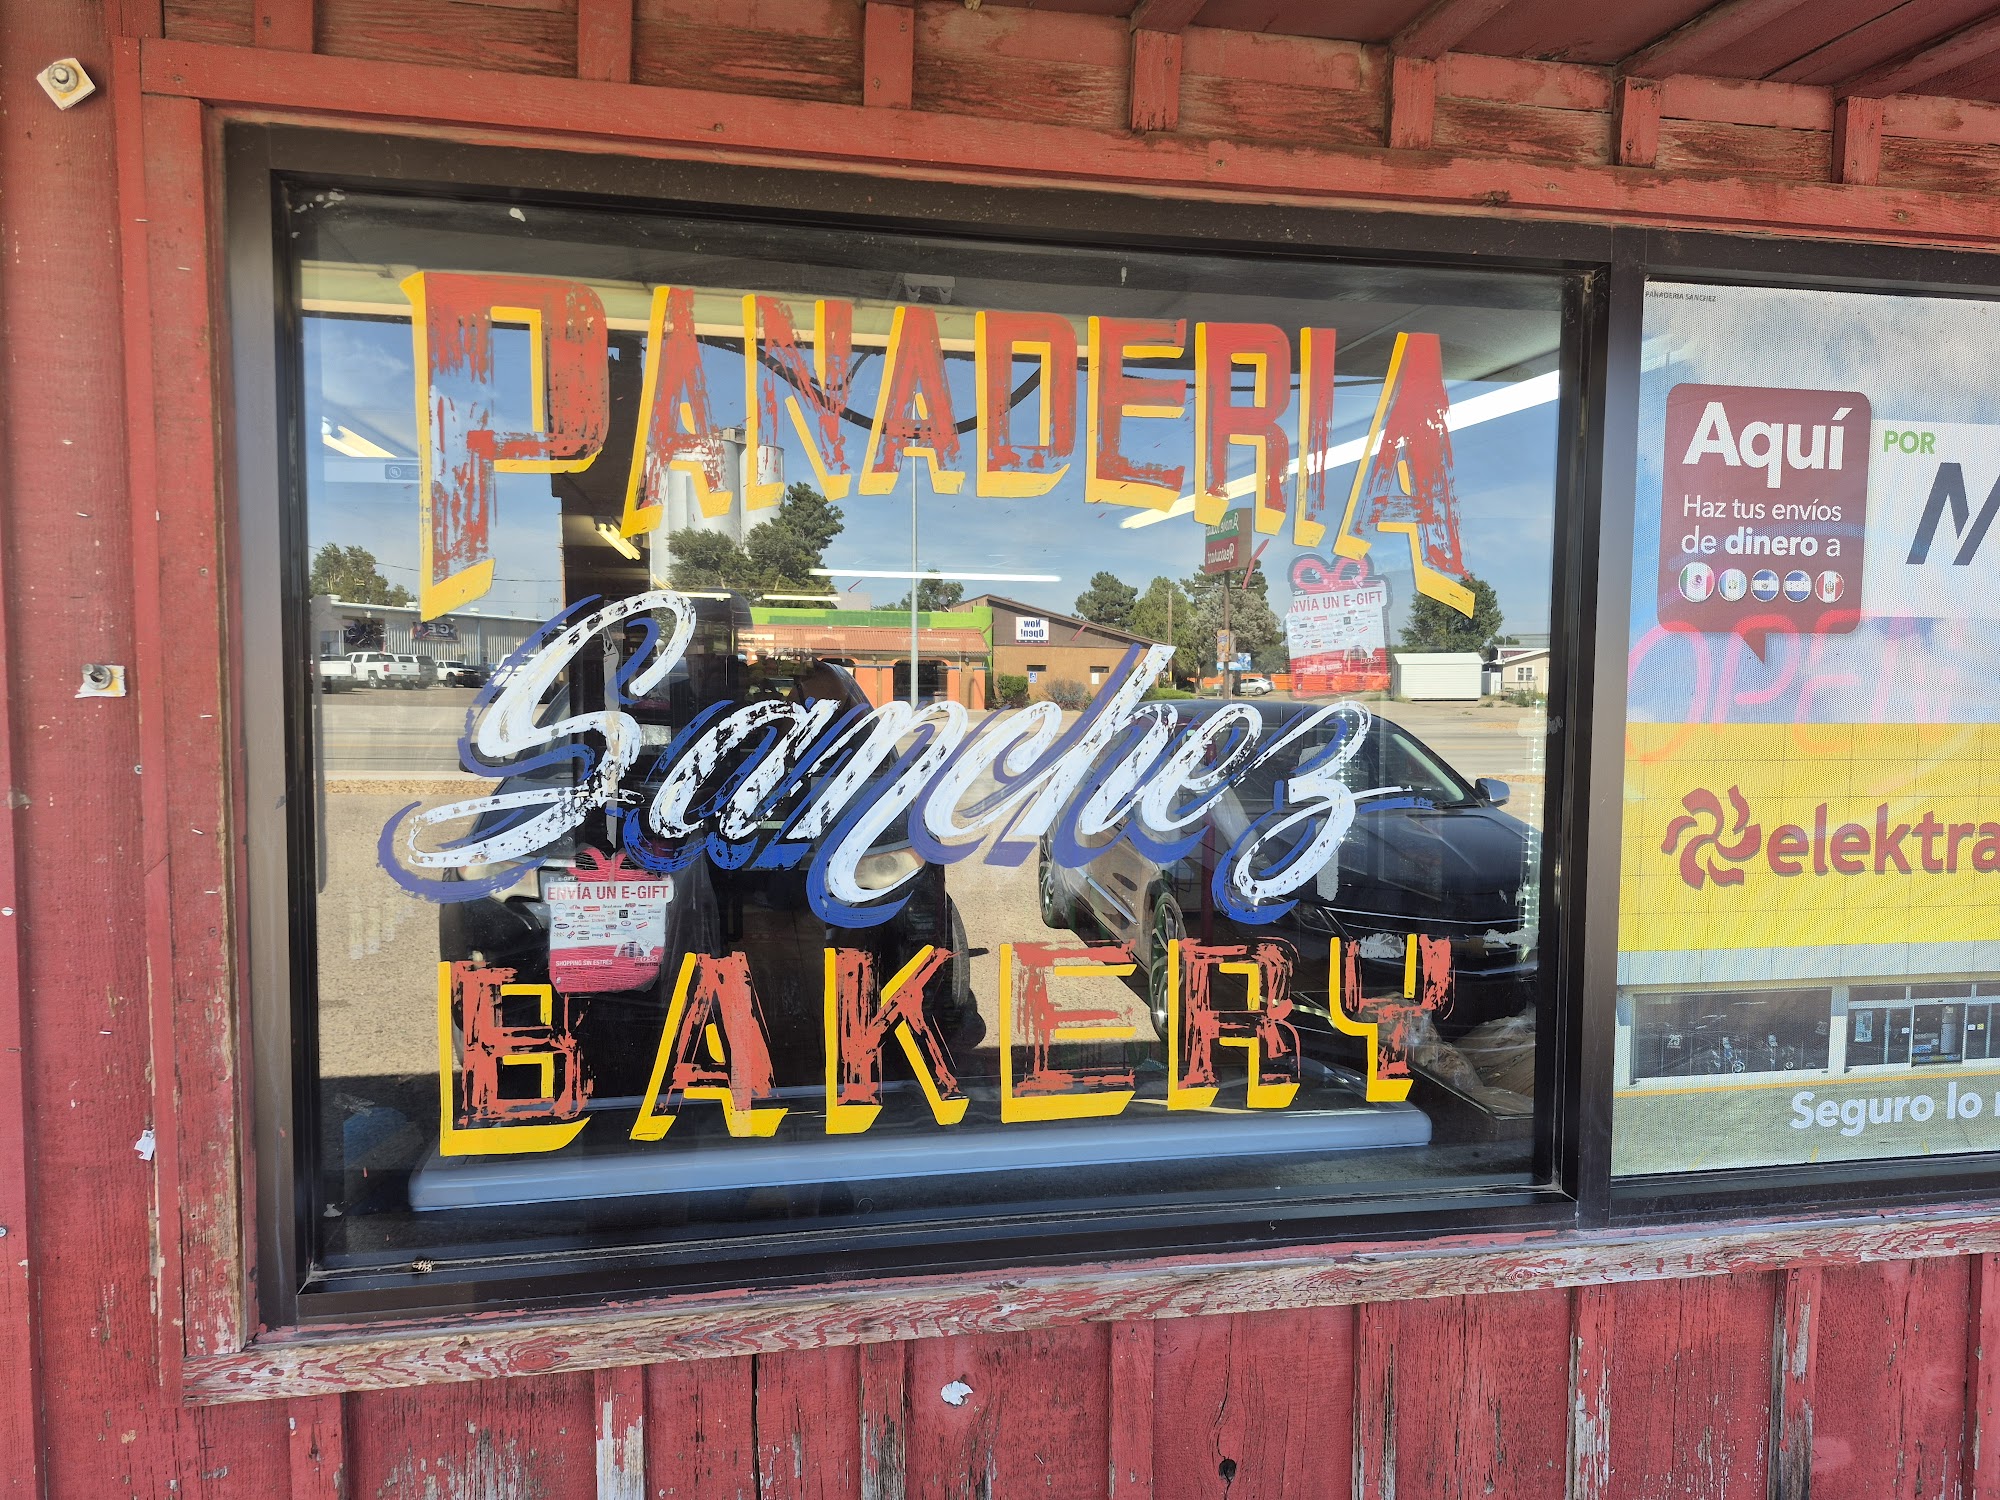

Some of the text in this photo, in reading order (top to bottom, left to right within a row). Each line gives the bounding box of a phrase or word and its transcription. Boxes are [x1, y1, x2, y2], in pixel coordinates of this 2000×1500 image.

[400, 270, 1476, 621] PANADERIA
[1682, 401, 1853, 489] Aquí
[1883, 430, 1936, 454] POR
[1683, 494, 1843, 522] Haz tus envíos
[1681, 525, 1842, 557] de dinero a
[1322, 596, 1340, 609] UN
[1343, 591, 1383, 607] E-GIFT
[378, 588, 1432, 928] Sanchez
[1767, 803, 2000, 877] elektra
[547, 883, 669, 901] ENVÍA UN E-GIFT
[439, 931, 1456, 1157] BAKERY
[1790, 1091, 1934, 1137] Seguro
[1947, 1082, 1983, 1119] lo
